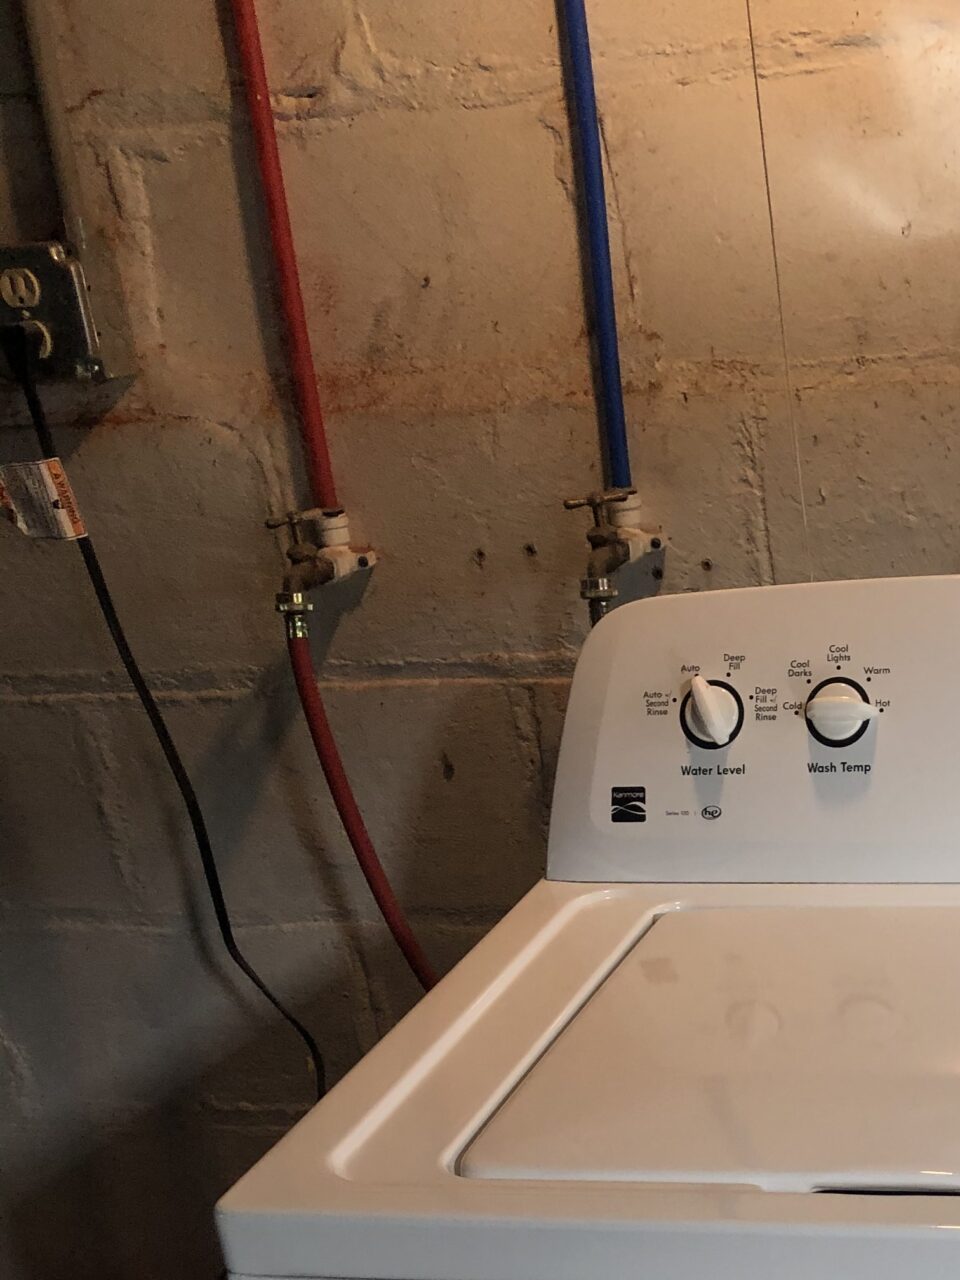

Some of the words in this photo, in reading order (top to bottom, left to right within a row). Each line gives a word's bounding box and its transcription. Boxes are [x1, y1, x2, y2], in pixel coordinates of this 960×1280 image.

[829, 644, 849, 653] Cool
[723, 653, 746, 663] Deep
[826, 654, 851, 664] Lights
[680, 664, 701, 673] Auto
[728, 662, 741, 671] Fill
[790, 660, 810, 669] Cool
[788, 669, 812, 678] Darks
[863, 666, 891, 675] Warm
[643, 691, 663, 699] Auto
[755, 686, 777, 696] Deep
[646, 699, 669, 708] Second
[755, 695, 767, 704] Fill
[875, 699, 891, 707] Hot
[754, 704, 778, 712] Second
[782, 701, 803, 710] Cold
[647, 707, 668, 716] Rinse
[755, 712, 777, 721] Rinse
[680, 765, 713, 776] Water
[717, 764, 746, 775] Level
[807, 762, 837, 773] Wash
[841, 761, 871, 774] Temp
